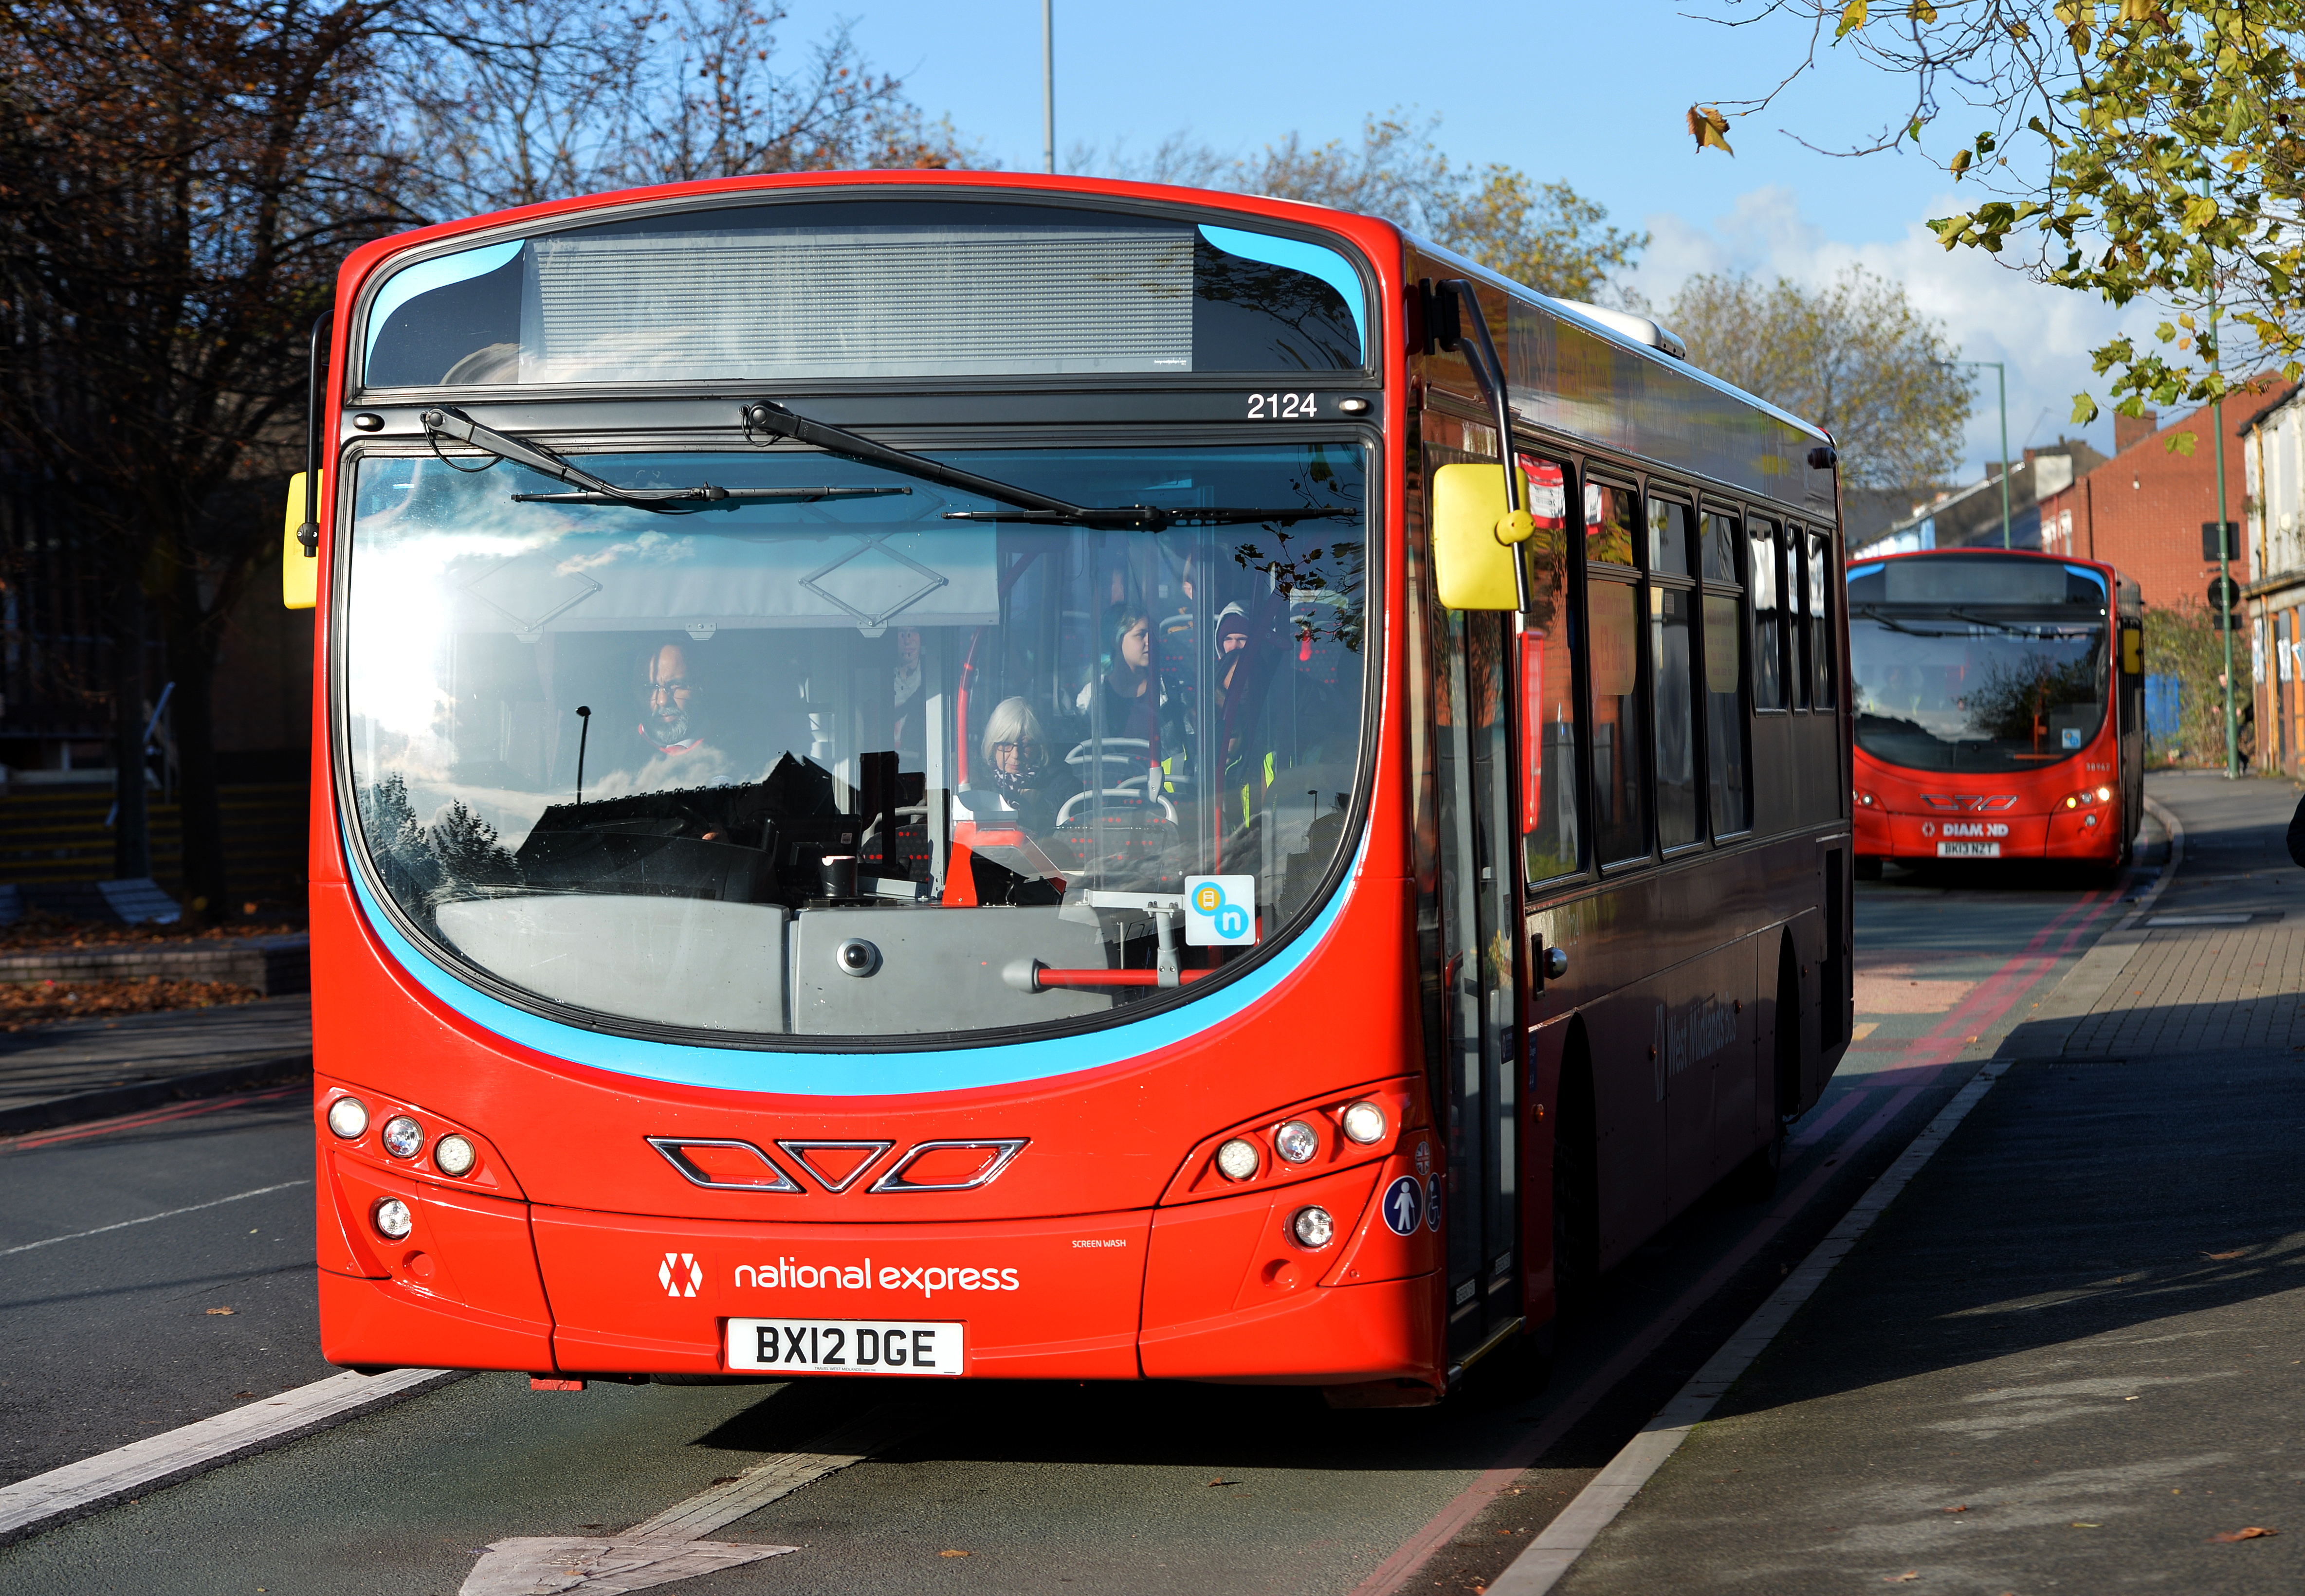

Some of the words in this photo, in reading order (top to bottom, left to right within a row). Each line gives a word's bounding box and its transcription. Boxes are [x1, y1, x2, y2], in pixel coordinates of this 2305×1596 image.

[1560, 350, 1581, 397] every
[1247, 393, 1317, 418] 2124
[1943, 823, 2009, 837] DIAMND
[1945, 843, 1969, 855] BK13
[1972, 843, 1993, 855] NZT
[1222, 912, 1241, 931] n
[1667, 1015, 1687, 1078] West
[1689, 991, 1724, 1065] Midlands
[1725, 991, 1736, 1044] Bus
[1072, 1240, 1102, 1248] SCREEN
[734, 1256, 871, 1289] national
[878, 1267, 1020, 1298] express
[756, 1326, 846, 1365] BX12
[856, 1329, 936, 1367] DGE
